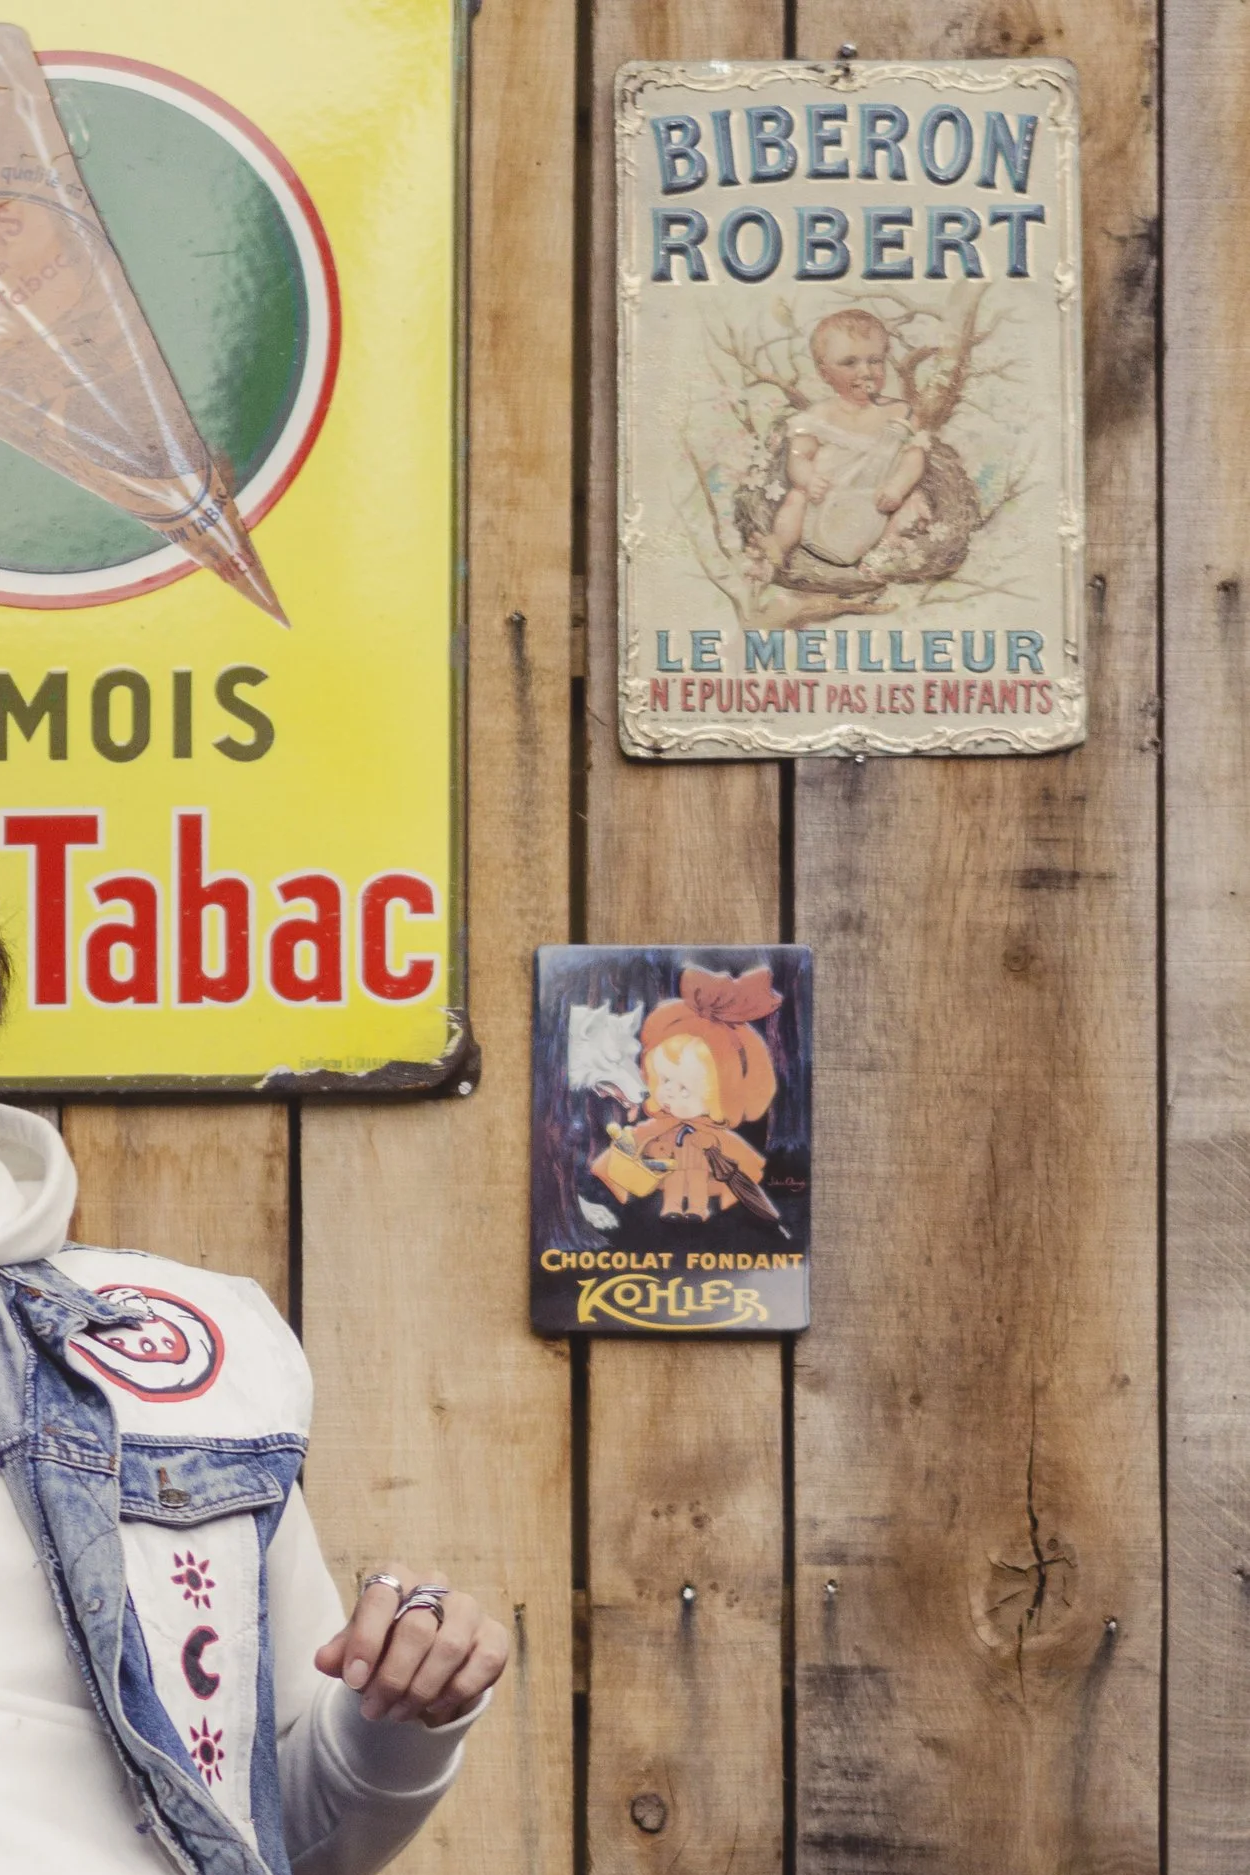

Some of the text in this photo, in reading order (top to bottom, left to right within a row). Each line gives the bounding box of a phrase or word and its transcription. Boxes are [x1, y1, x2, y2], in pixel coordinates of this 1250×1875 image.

[651, 102, 1038, 196] BIBERON
[651, 203, 1046, 284] ROBERT
[656, 629, 1045, 675] LE MEILLEUR
[825, 683, 868, 715] PAS
[875, 683, 915, 715] LES
[923, 678, 1053, 716] ENFANTS
[2, 811, 438, 1007] Tabac
[540, 1248, 804, 1272] CHOCOLAT FONDANT
[576, 1273, 769, 1331] KOHLER
